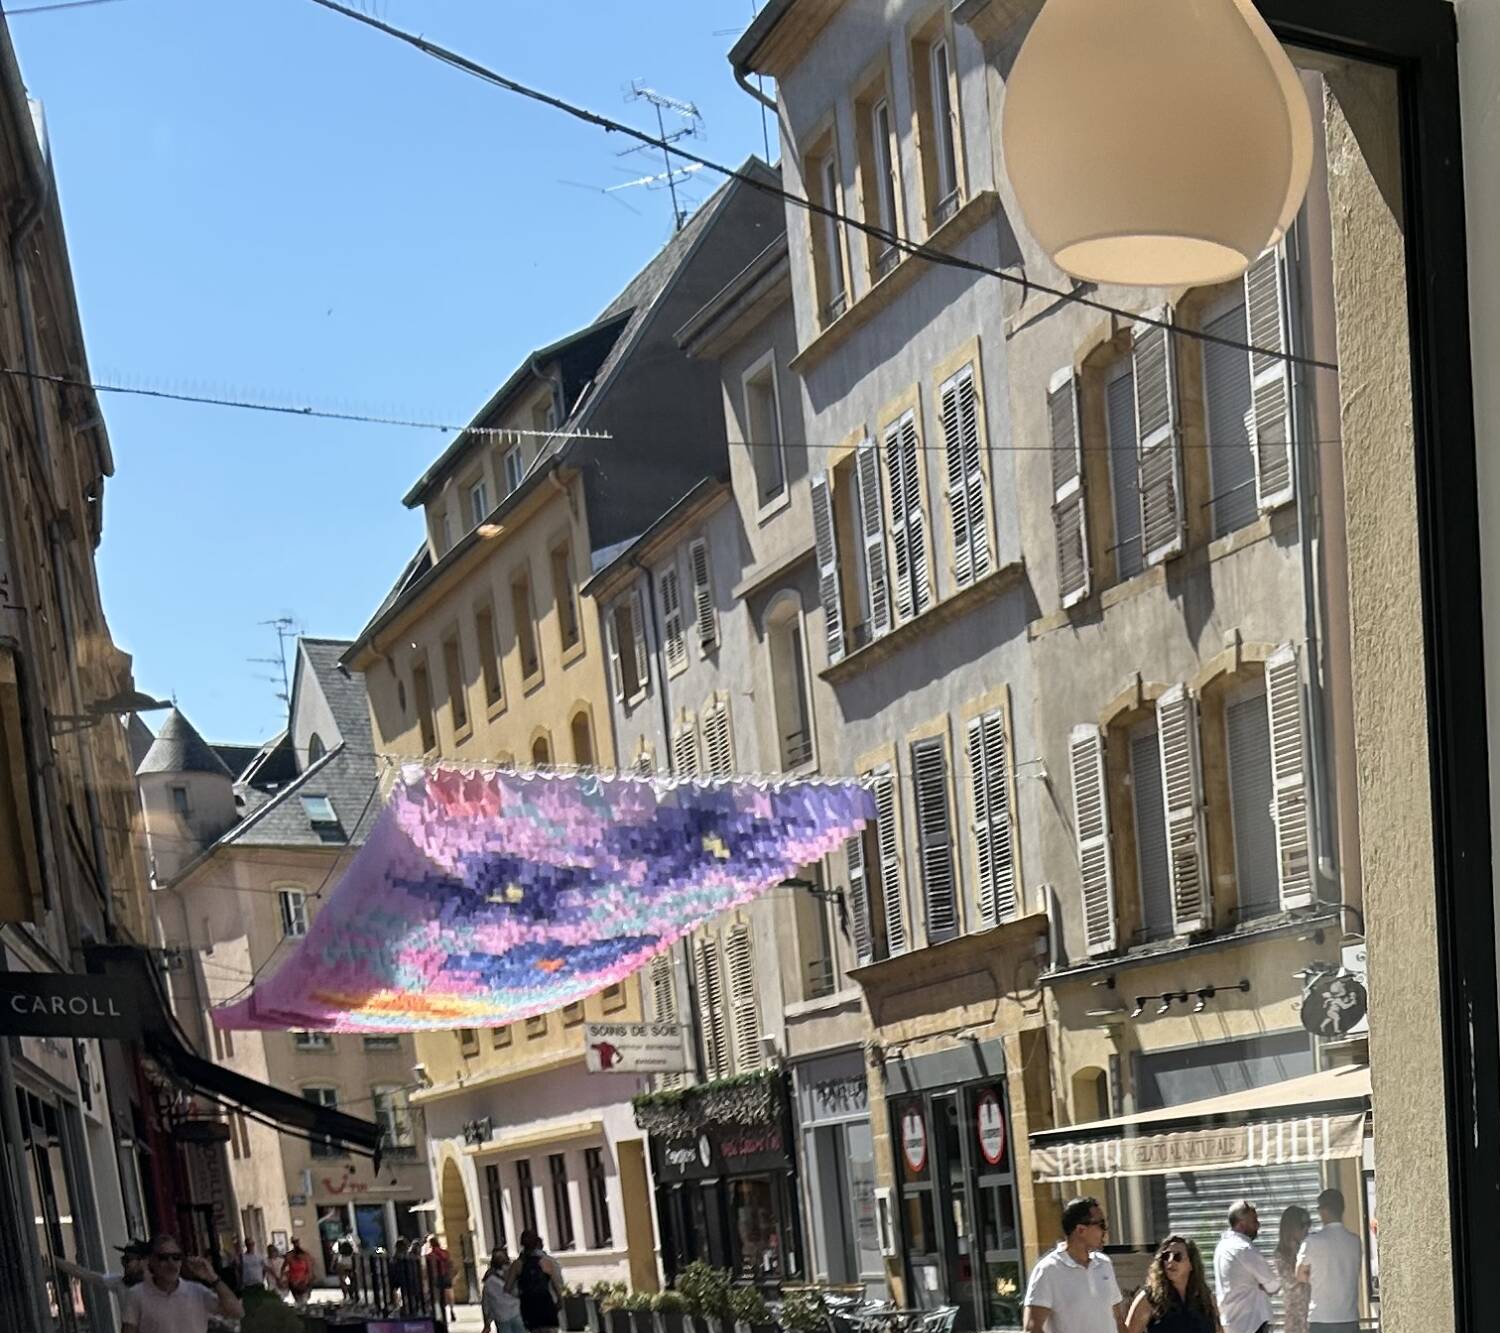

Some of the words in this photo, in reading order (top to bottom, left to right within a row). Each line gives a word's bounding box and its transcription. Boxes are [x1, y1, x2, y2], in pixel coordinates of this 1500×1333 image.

[10, 995, 121, 1016] CAROLL
[631, 1026, 648, 1037] DE
[651, 1026, 679, 1037] SOIE
